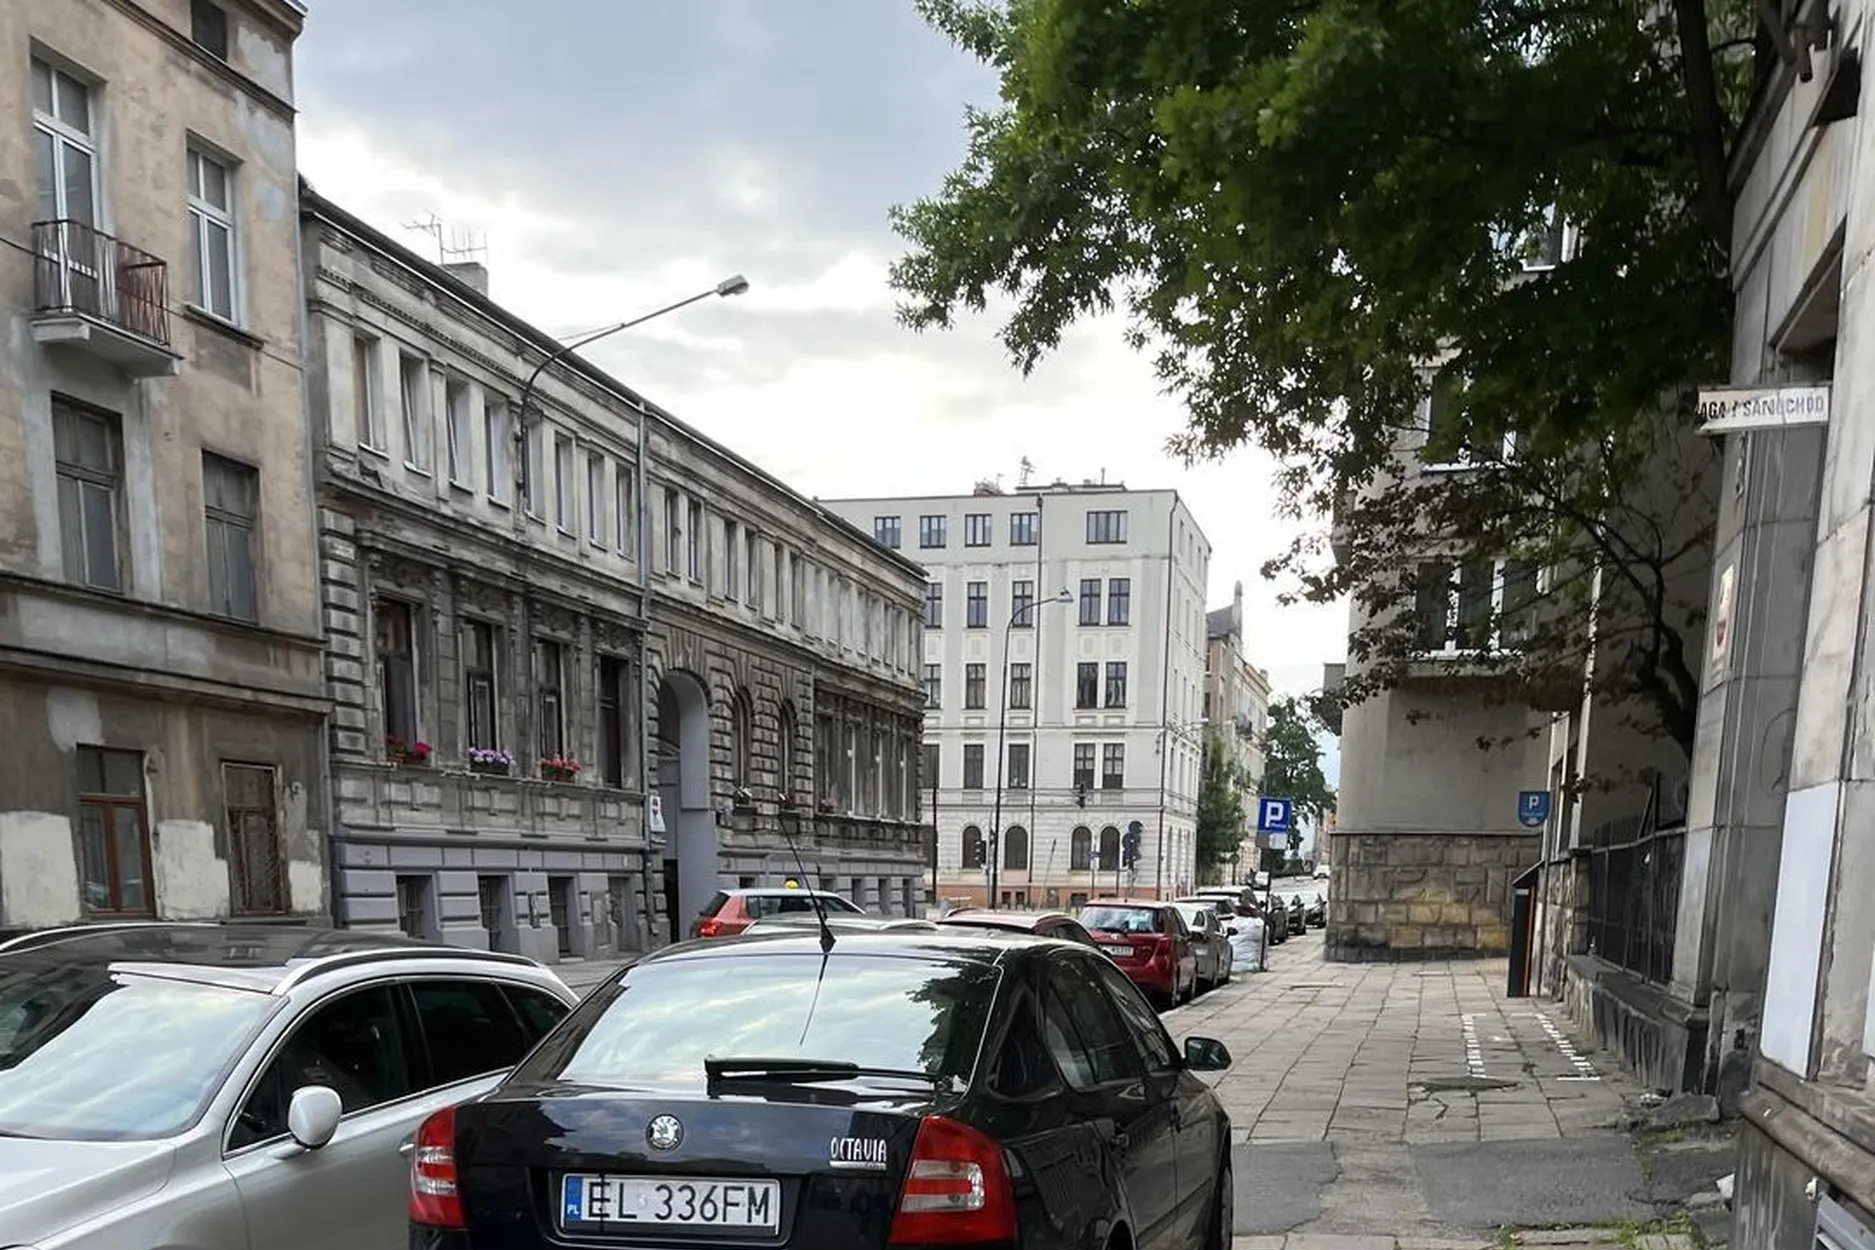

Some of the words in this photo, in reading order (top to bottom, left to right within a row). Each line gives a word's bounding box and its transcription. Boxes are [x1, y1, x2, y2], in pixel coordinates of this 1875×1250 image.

[1265, 801, 1284, 828] P
[1529, 795, 1540, 809] P
[830, 1136, 887, 1162] OCTAVIA
[587, 1181, 638, 1219] EL
[654, 1183, 770, 1224] 336FM
